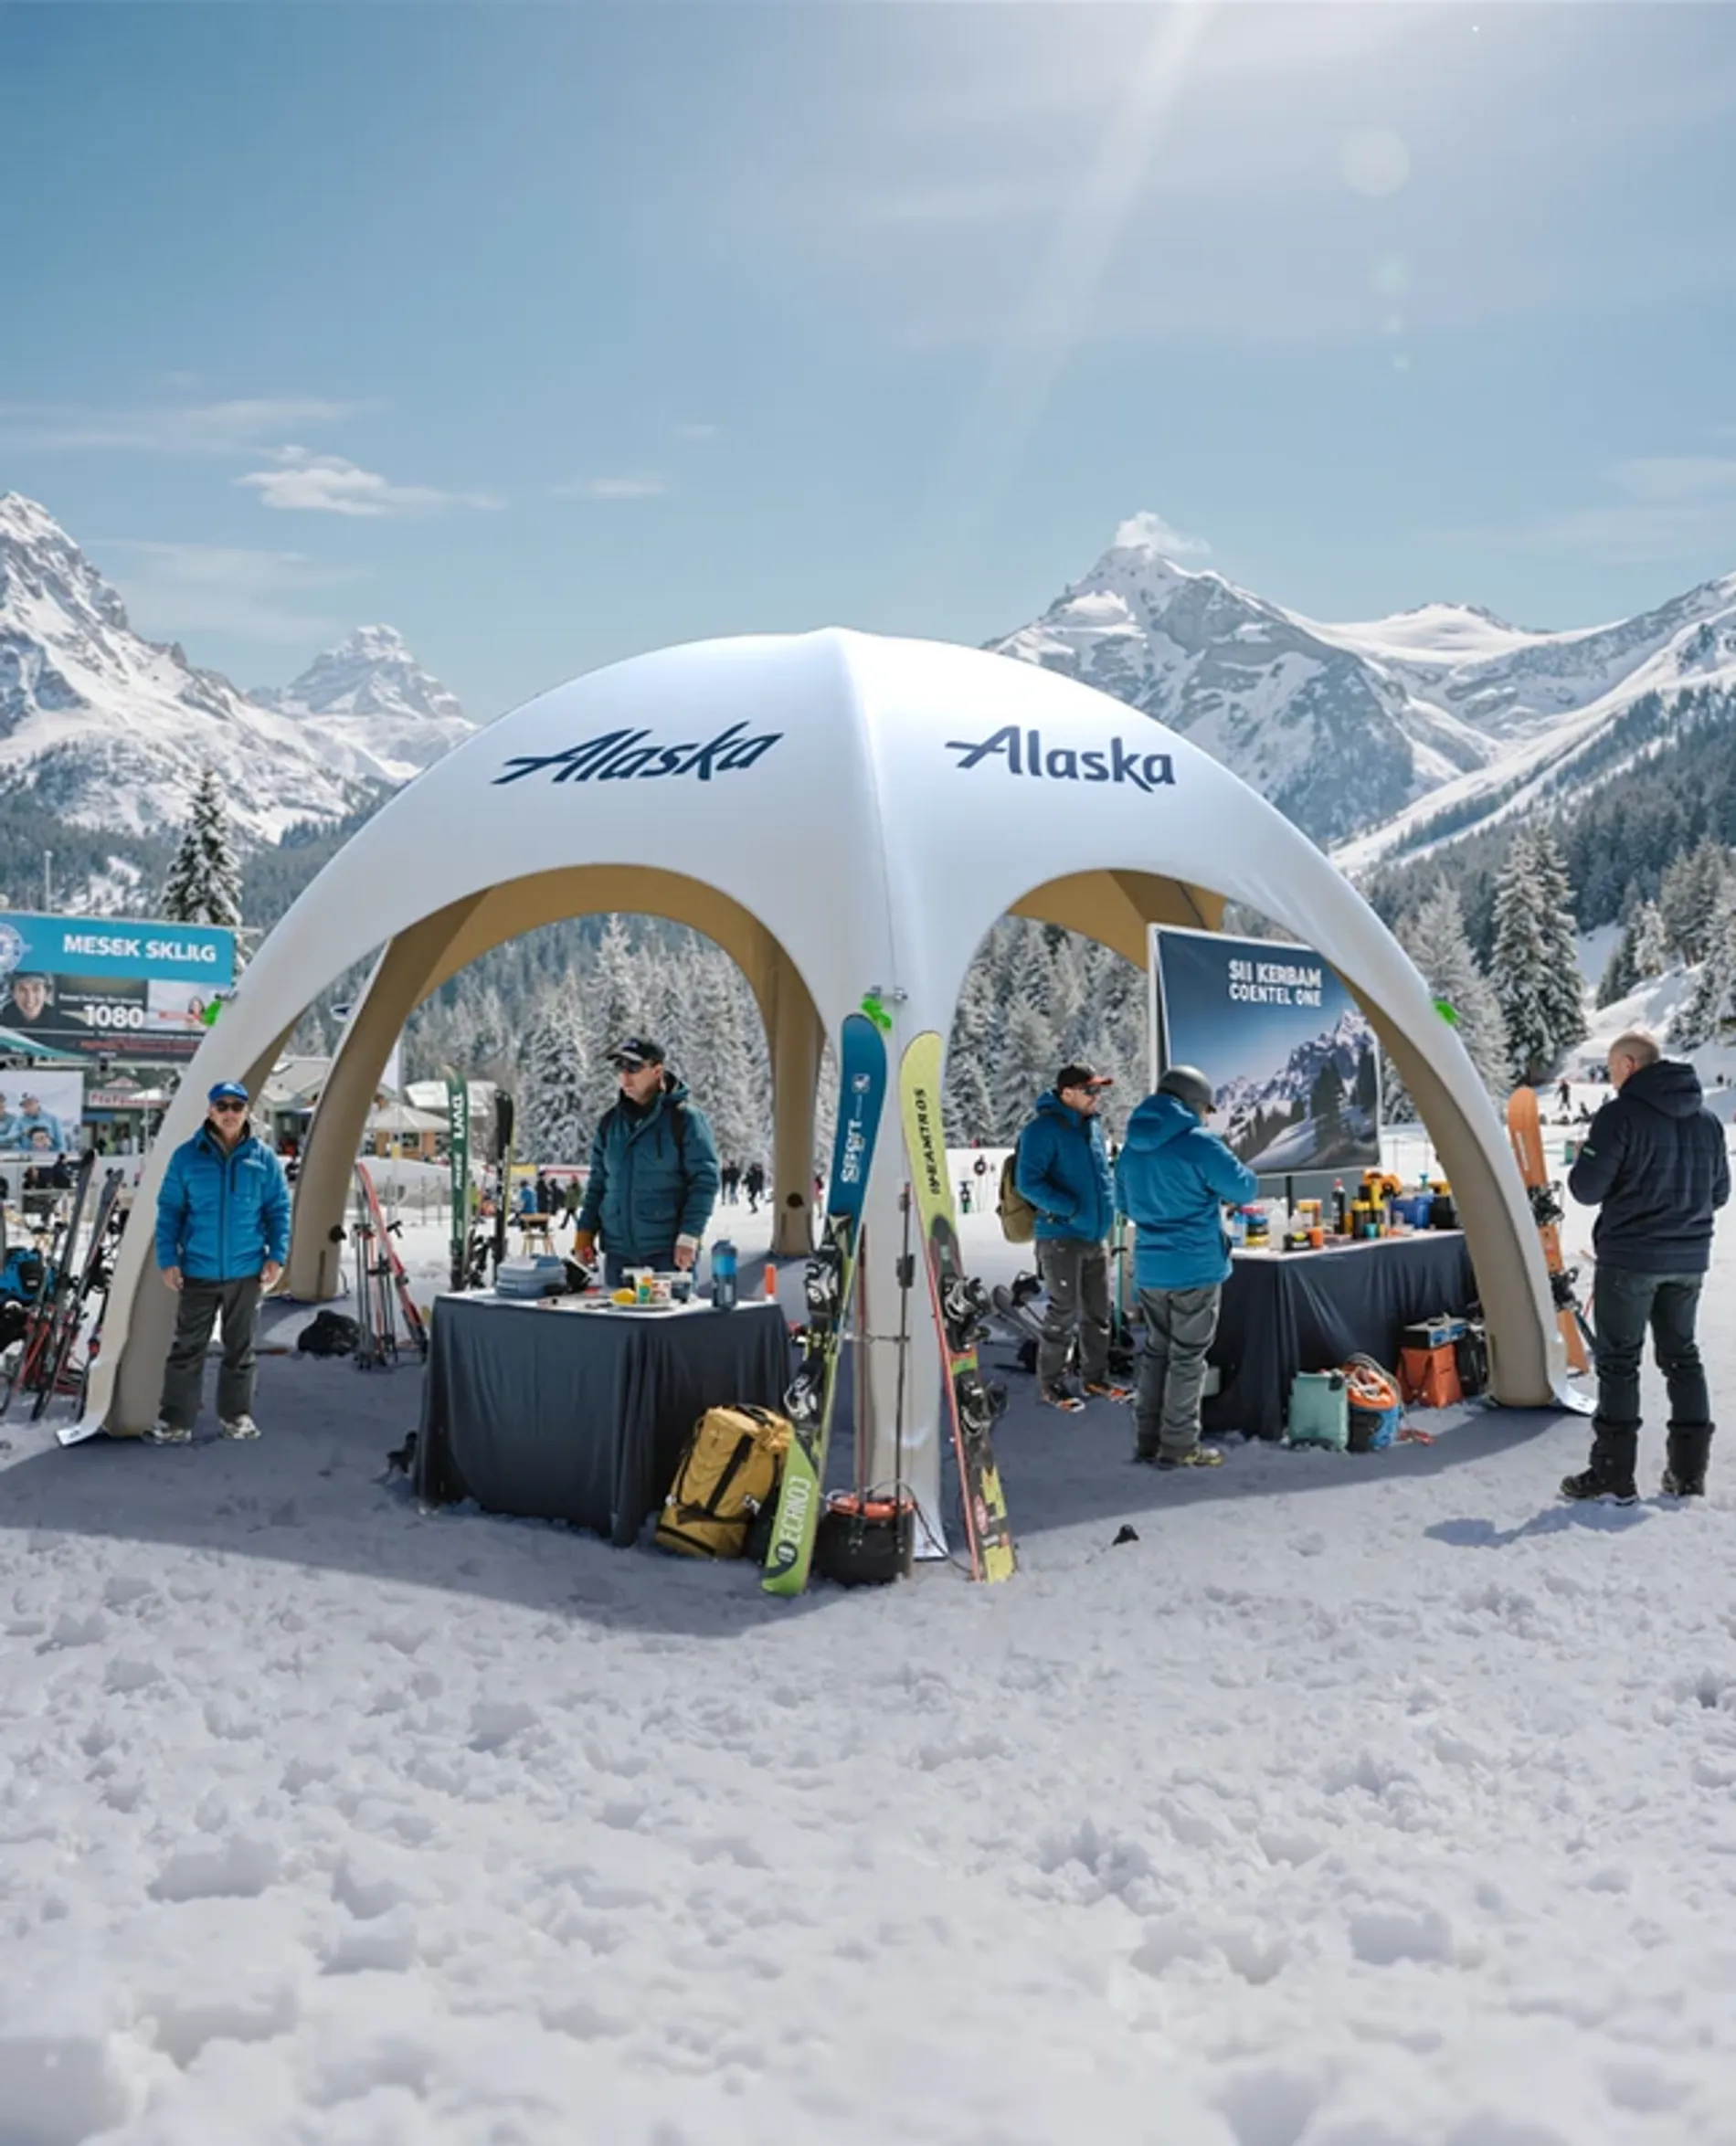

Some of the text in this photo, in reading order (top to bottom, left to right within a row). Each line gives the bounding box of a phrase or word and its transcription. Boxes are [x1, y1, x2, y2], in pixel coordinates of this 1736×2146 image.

[491, 720, 784, 785] Alaska
[945, 724, 1176, 793] Alaska
[83, 1004, 143, 1029] 1080
